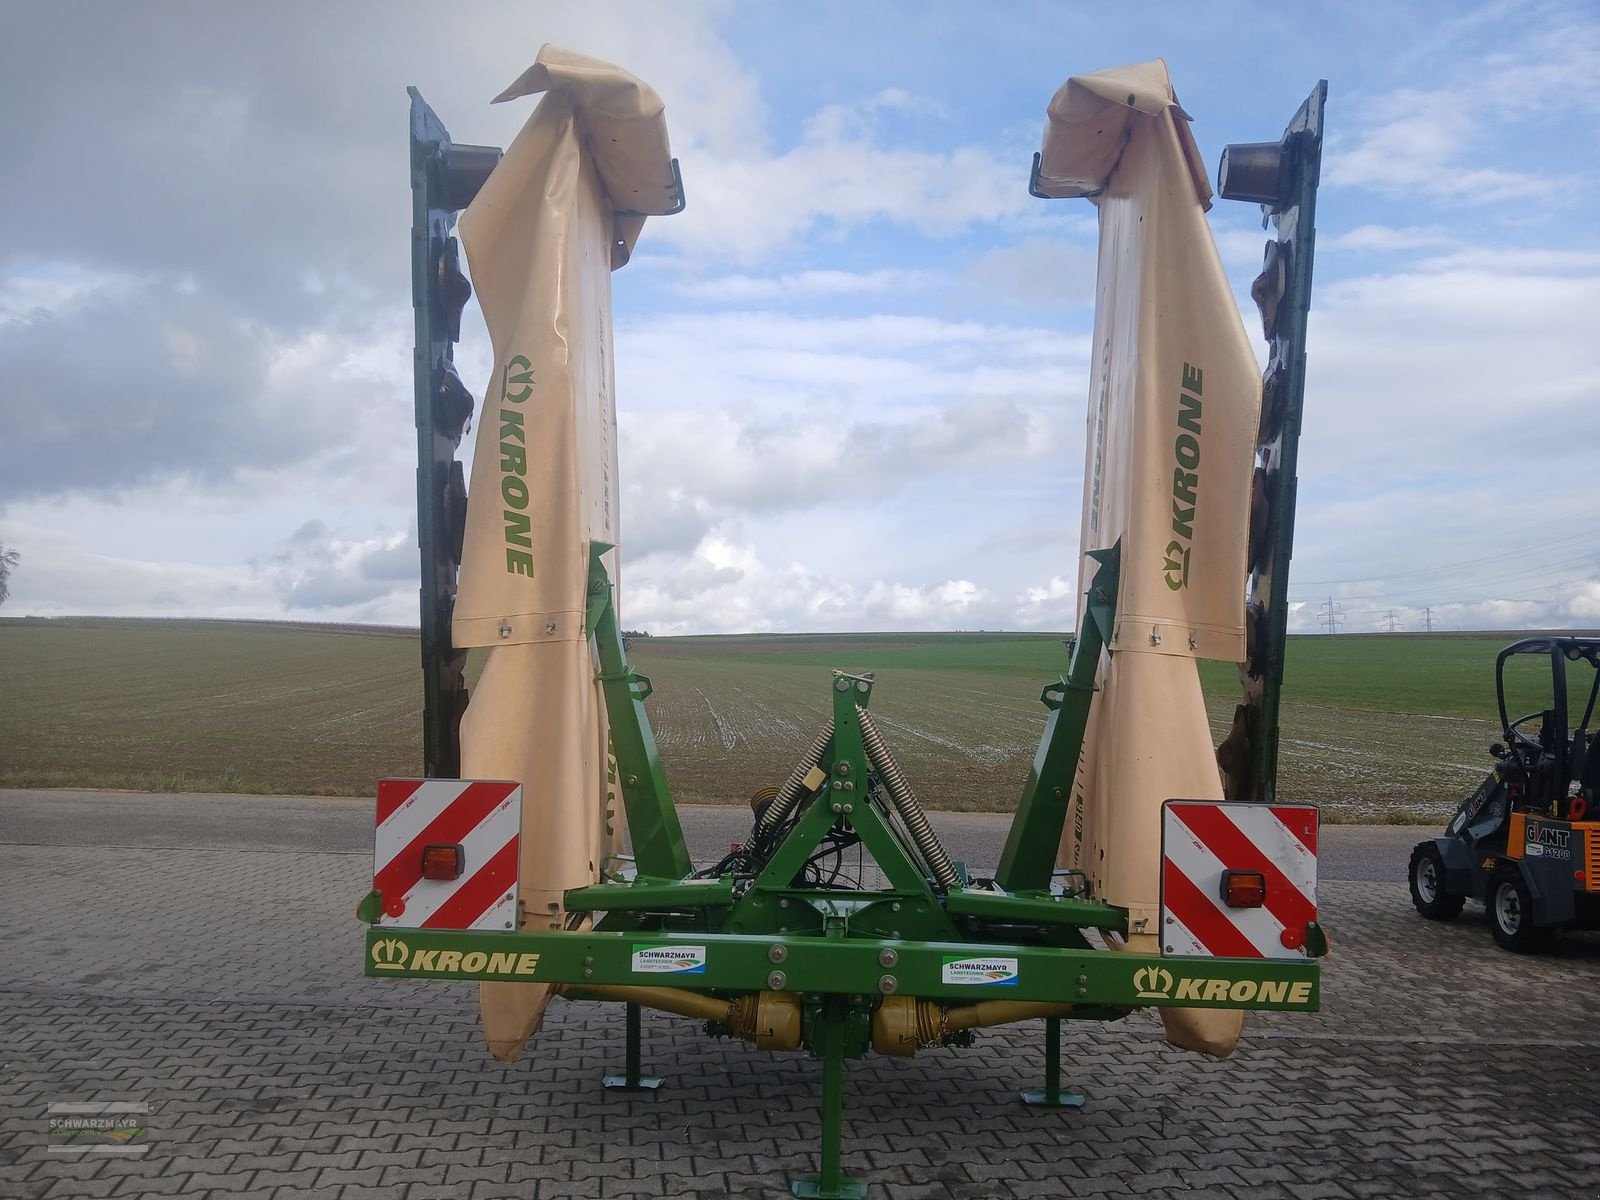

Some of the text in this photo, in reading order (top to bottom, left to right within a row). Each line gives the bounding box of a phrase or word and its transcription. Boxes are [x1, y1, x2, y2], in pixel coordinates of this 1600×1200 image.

[1172, 362, 1203, 540] KRONE
[500, 408, 535, 579] KRONE
[410, 948, 540, 975] KRONE
[639, 951, 696, 959] SCHWARZMAYR
[949, 963, 1007, 971] SCHWARZMAYR
[1174, 978, 1313, 1004] KRONE
